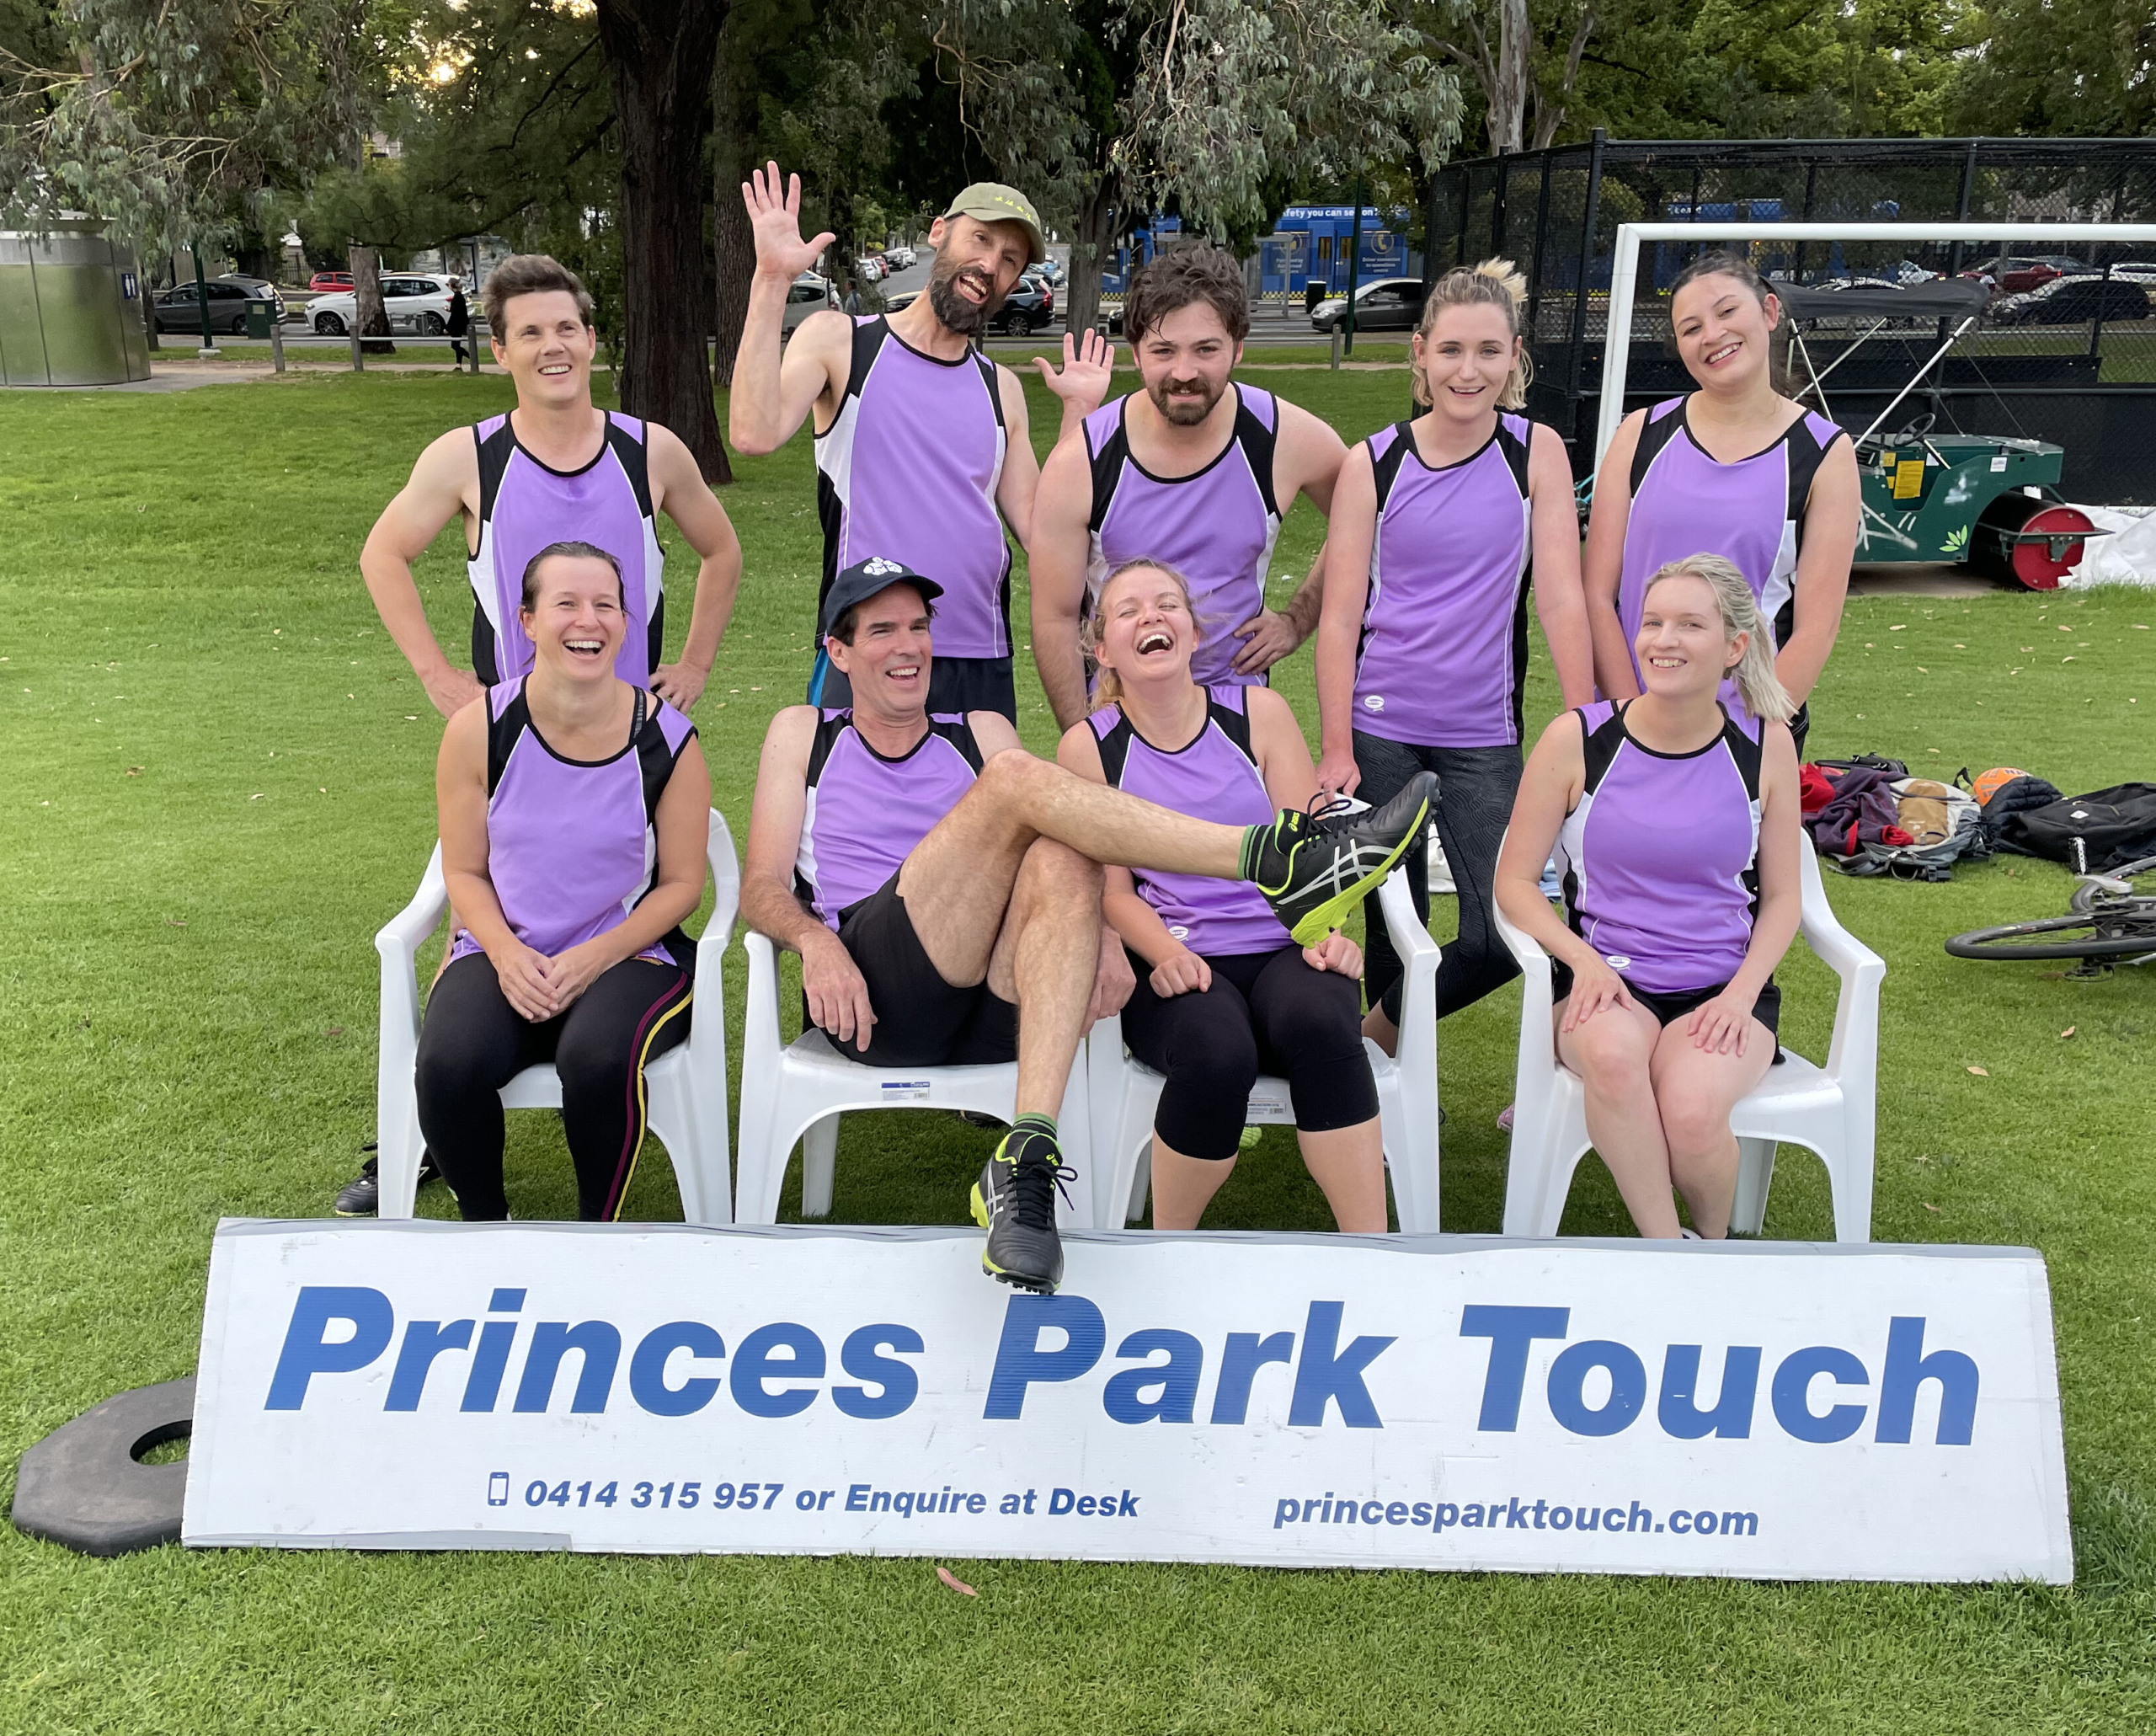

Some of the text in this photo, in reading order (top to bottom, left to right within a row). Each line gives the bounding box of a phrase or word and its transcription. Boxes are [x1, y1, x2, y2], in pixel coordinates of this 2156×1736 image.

[1307, 210, 1324, 219] you
[264, 1285, 1979, 1445] Princes Park Touch
[525, 1480, 1139, 1519] 0414 315 957 or Enquire at Desk
[1274, 1492, 1758, 1536] princesparktouch.com
